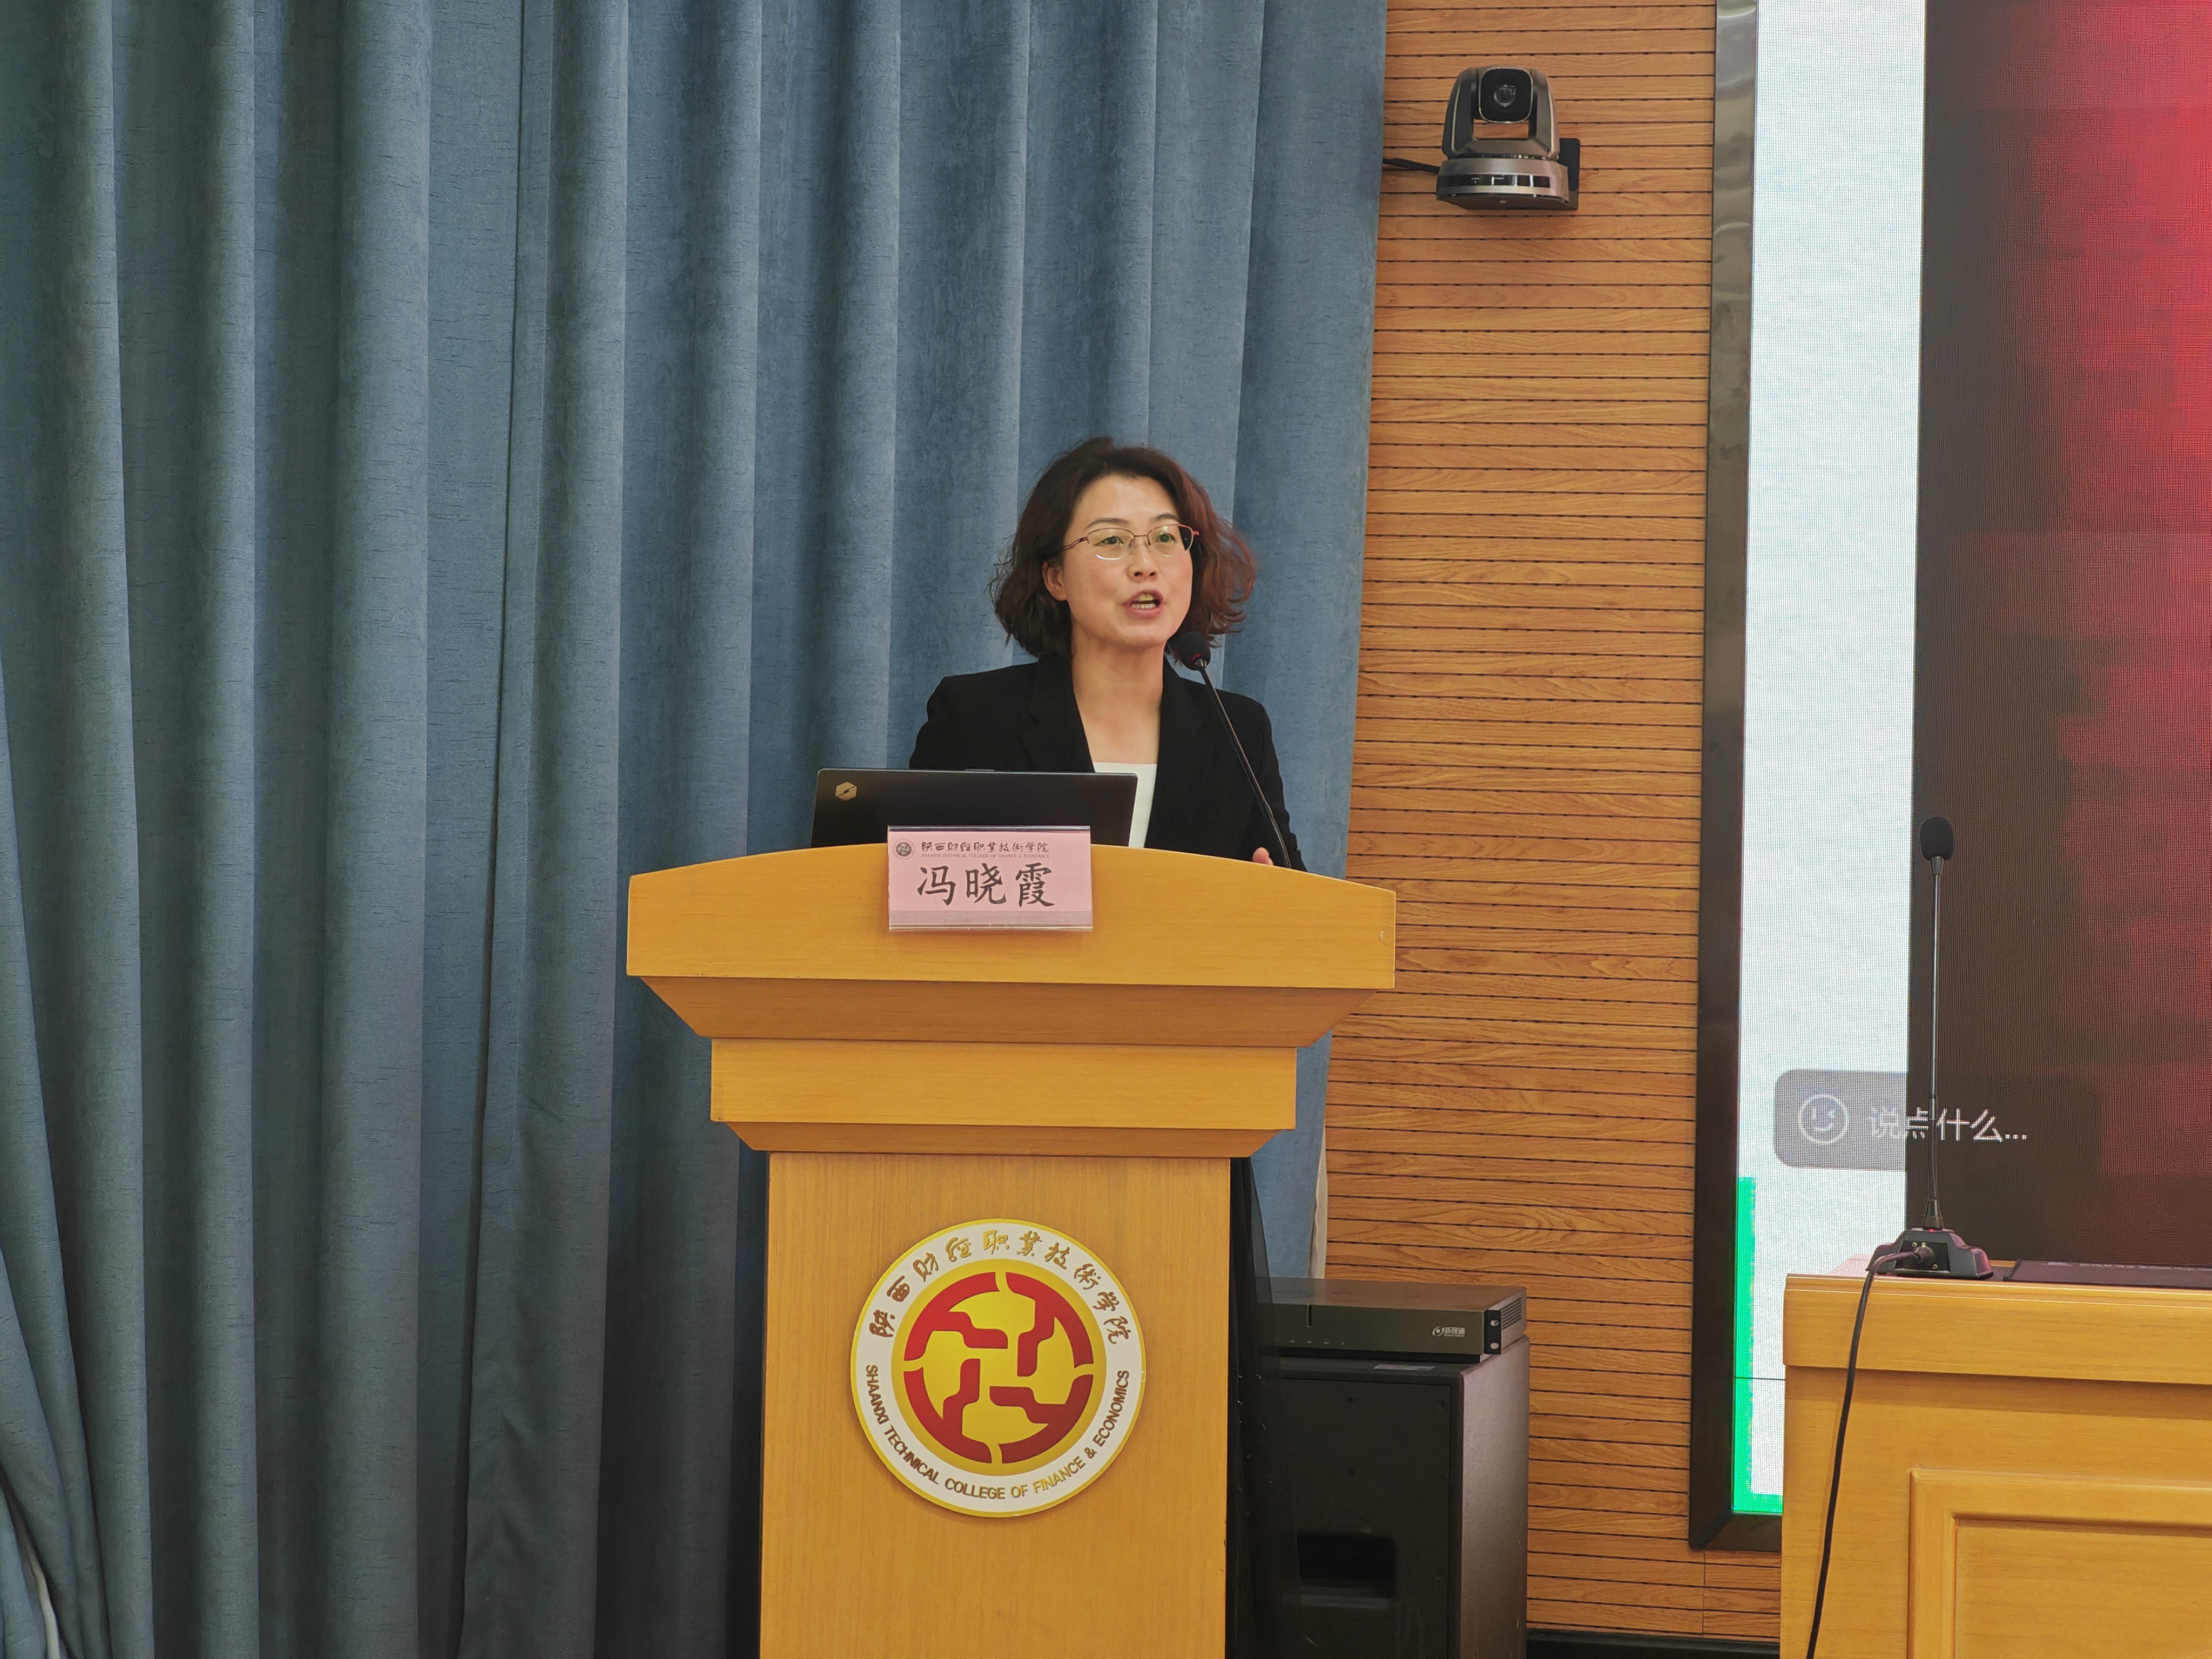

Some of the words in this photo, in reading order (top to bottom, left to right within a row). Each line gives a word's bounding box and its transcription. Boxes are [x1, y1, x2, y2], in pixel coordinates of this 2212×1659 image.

[917, 862, 1055, 907] 冯晓霞
[866, 1364, 890, 1425] SHAANXI
[884, 1425, 939, 1485] TECHNICAL
[945, 1478, 1006, 1500] COLLEGE
[1010, 1484, 1028, 1499] OF
[1032, 1455, 1087, 1494] FINANCE
[1084, 1447, 1098, 1459] &
[1092, 1370, 1130, 1447] ECONOMICS
